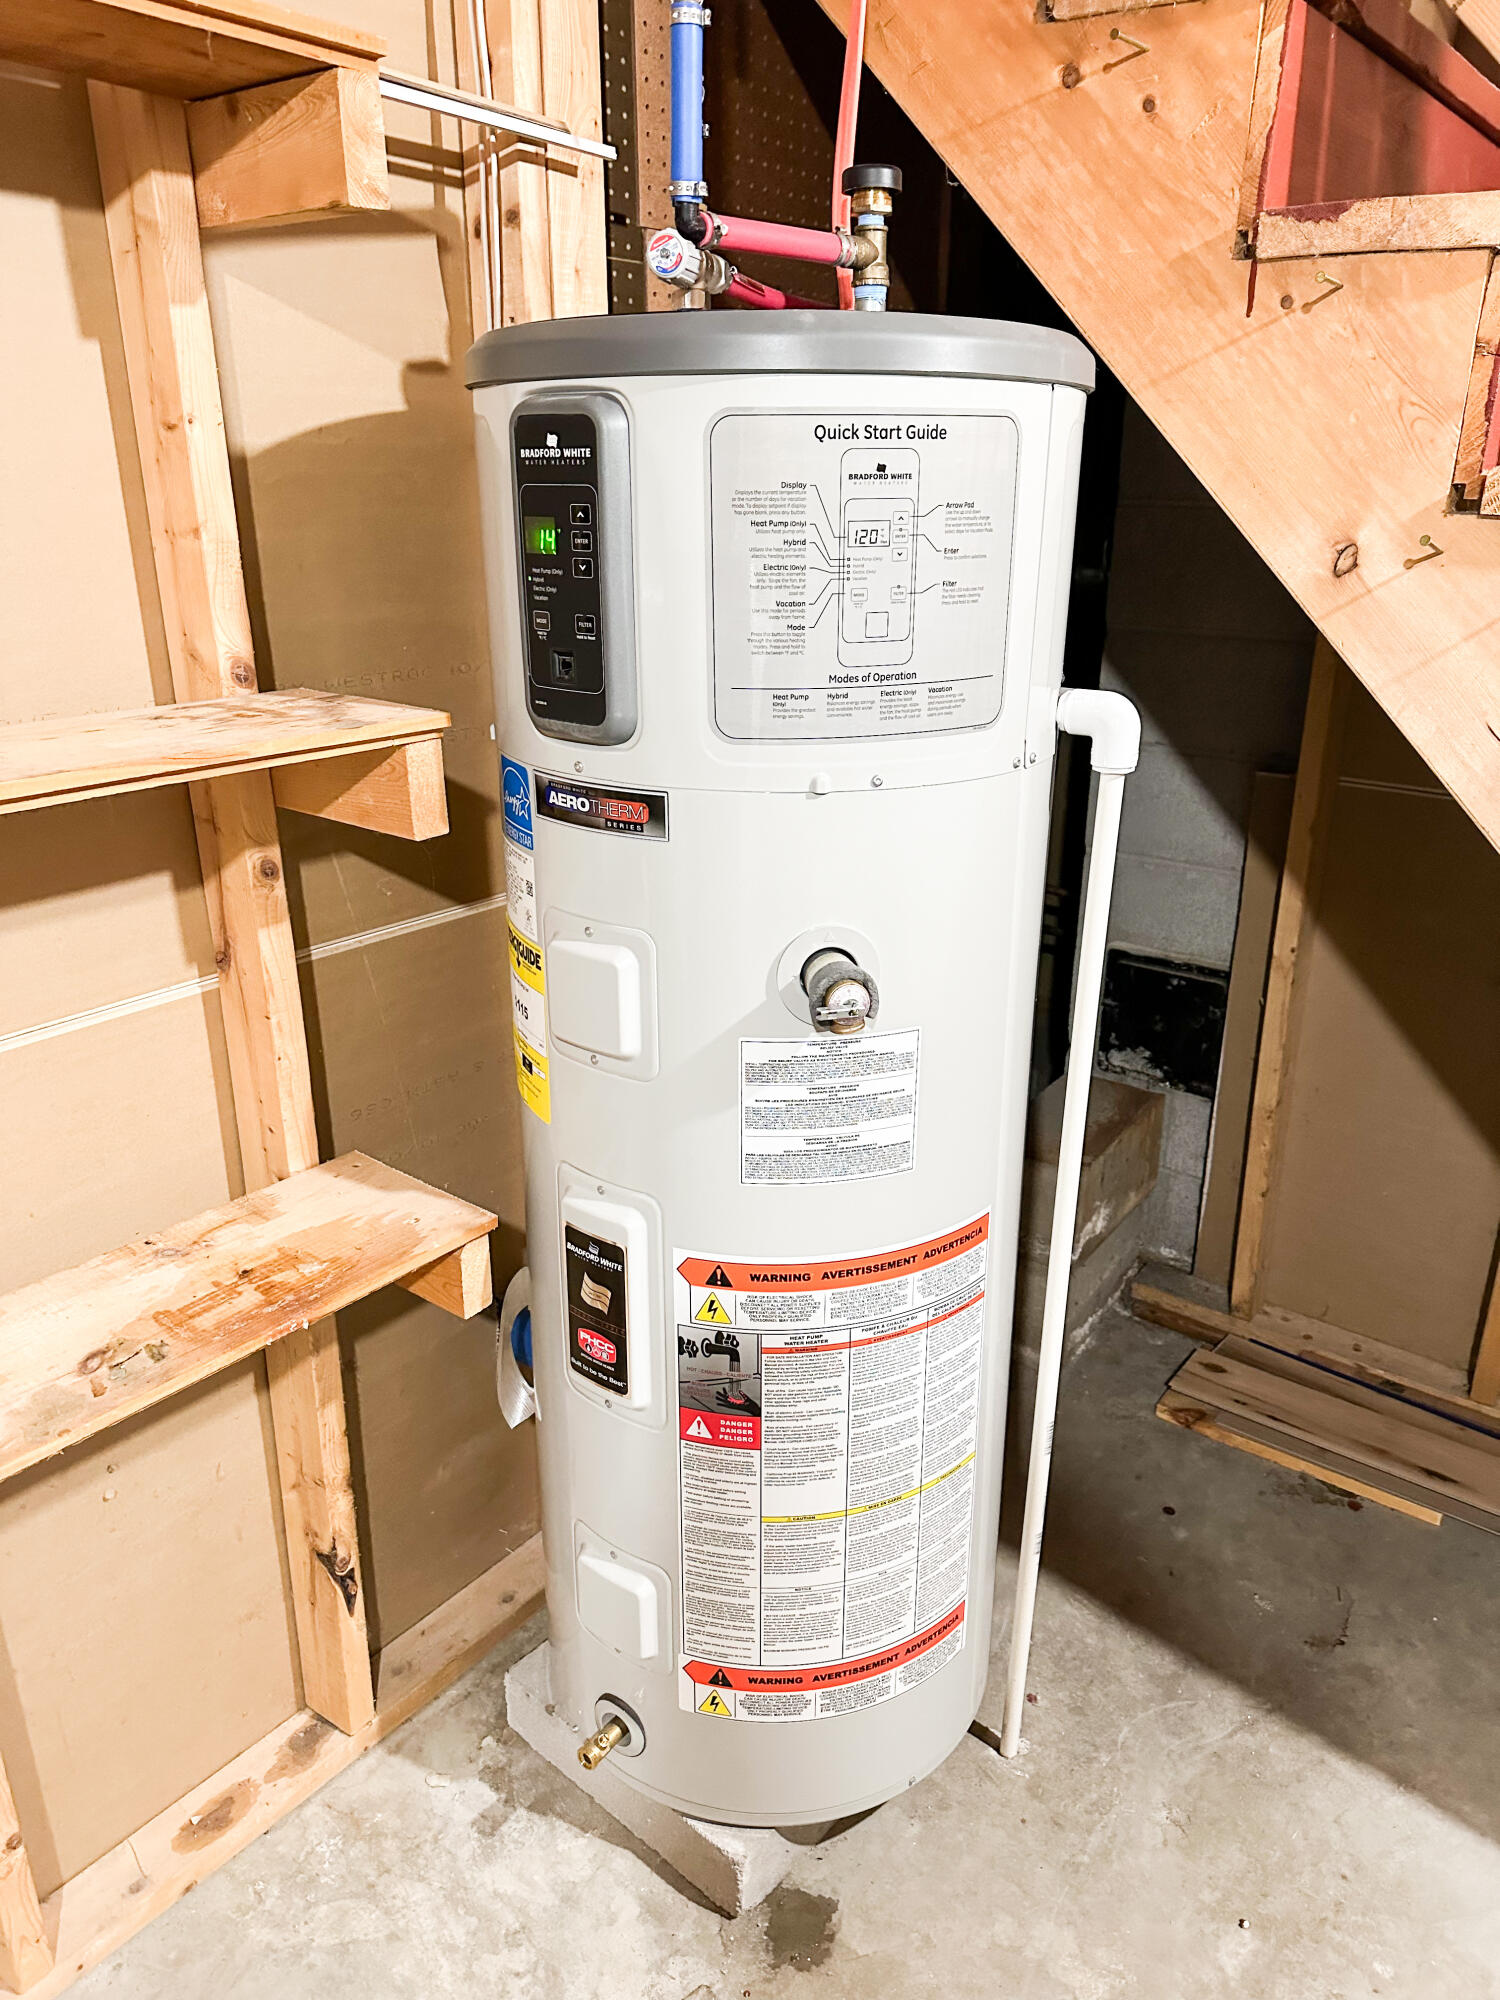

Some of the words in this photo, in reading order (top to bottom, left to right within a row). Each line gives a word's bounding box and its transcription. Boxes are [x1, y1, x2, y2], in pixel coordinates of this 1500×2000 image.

[814, 423, 860, 443] Quick
[863, 423, 902, 440] Start
[905, 423, 948, 440] Guide
[520, 447, 561, 458] BRADFORD
[562, 447, 592, 458] WHITE
[551, 459, 586, 467] HEATERS
[848, 473, 889, 481] BRADFORD
[781, 481, 808, 490] Display
[750, 520, 767, 528] Heat
[768, 520, 789, 528] Pump
[790, 520, 807, 528] (Only)
[574, 535, 588, 543] ENTER
[854, 528, 879, 545] 120
[783, 539, 806, 547] Hybrid
[944, 547, 960, 555] Enter
[763, 563, 789, 571] Electric
[789, 563, 807, 571] (Only)
[776, 600, 806, 608] Vacation
[578, 620, 593, 629] FILTER
[828, 673, 859, 684] Modes
[861, 671, 872, 683] of
[873, 671, 917, 684] Operation
[880, 689, 902, 697] Electric
[928, 685, 953, 694] Vacation
[790, 694, 809, 703] Pump
[827, 692, 849, 701] Hybrid
[549, 790, 645, 821] AEROTHERM
[606, 821, 643, 832] SERIES
[519, 831, 533, 849] STAR
[567, 1241, 600, 1262] BRADFORD
[600, 1257, 623, 1272] WHITE
[749, 1272, 811, 1282] WARNING
[821, 1254, 918, 1280] AVERTISSEMENT
[922, 1226, 983, 1261] ADVERTENCIA
[580, 1330, 615, 1354] PHCC
[571, 1356, 582, 1368] Built
[582, 1363, 589, 1371] to
[589, 1367, 597, 1376] be
[598, 1372, 608, 1381] the
[720, 1420, 753, 1428] DANGER
[748, 1676, 803, 1685] WARNING
[812, 1653, 900, 1682] AVERTISSEMENT
[904, 1614, 959, 1656] ADVERTENCIA
